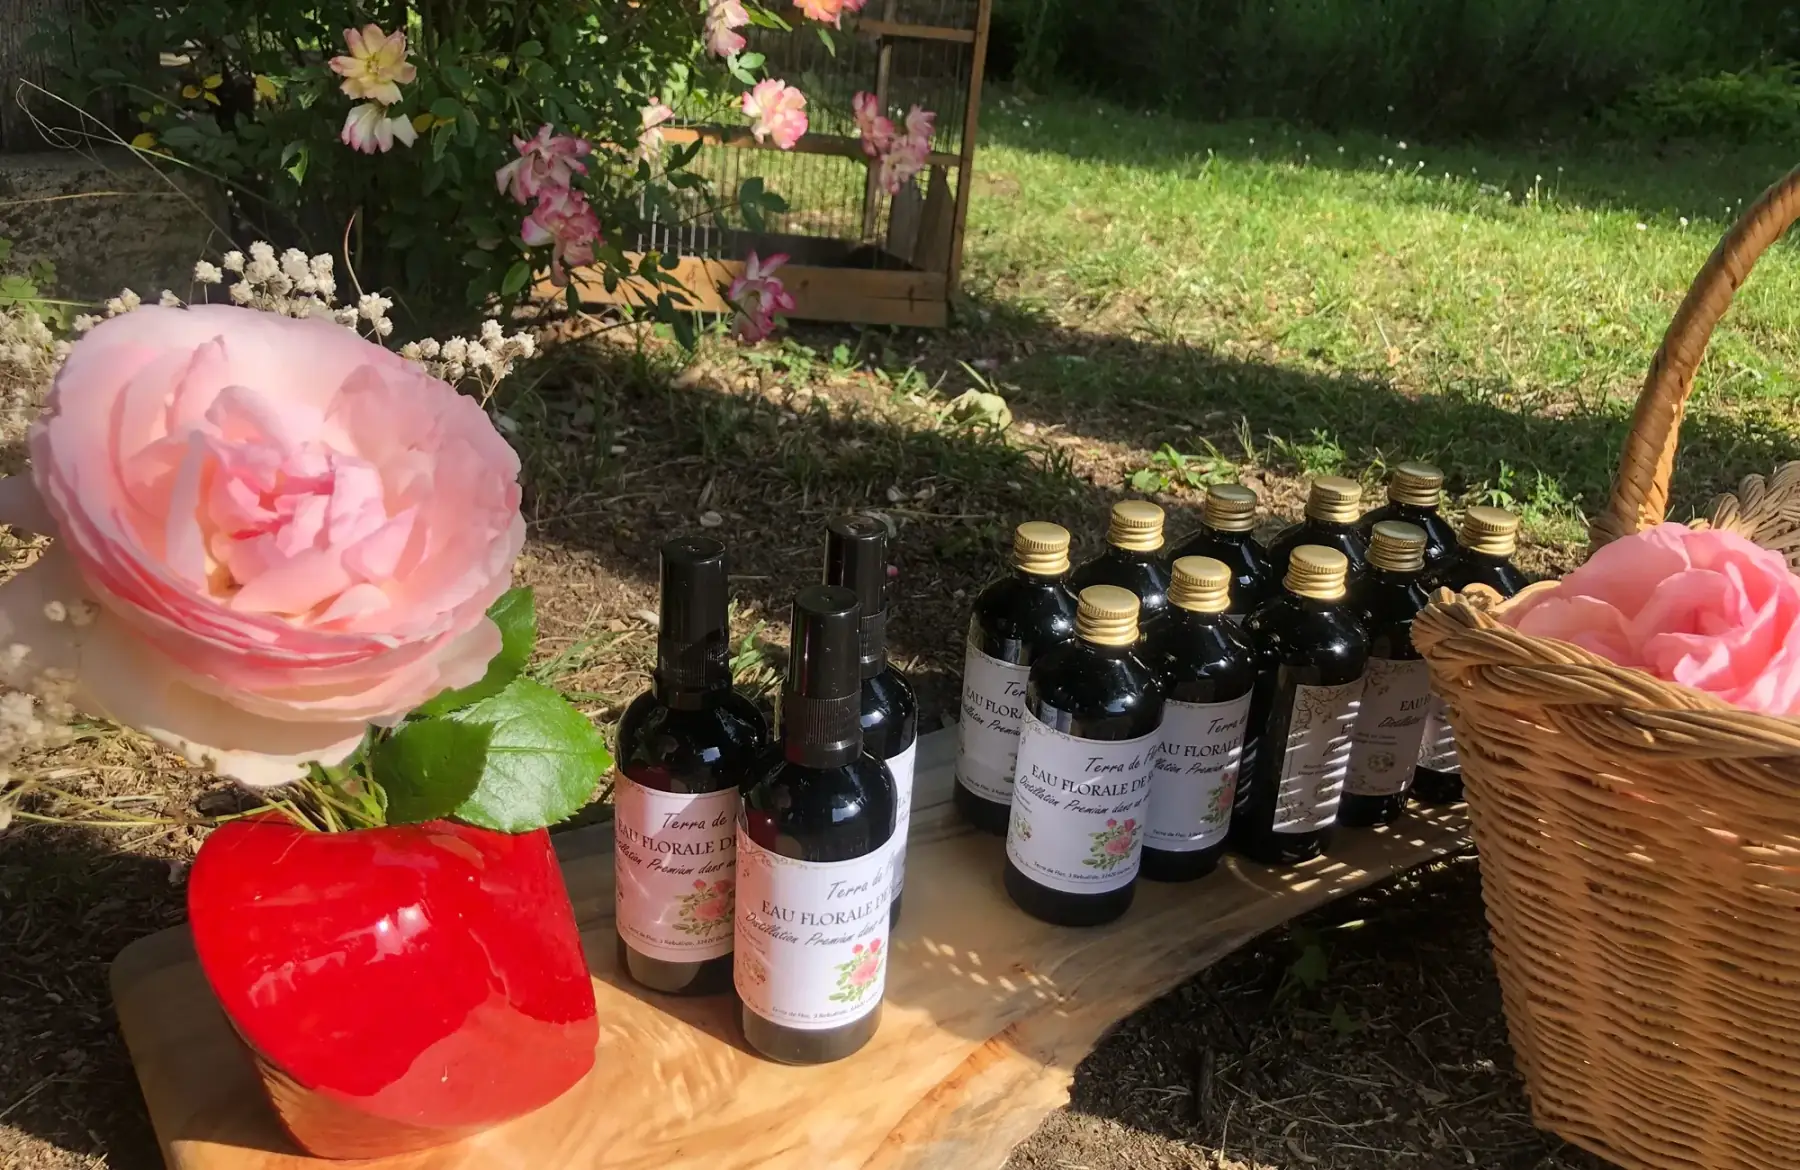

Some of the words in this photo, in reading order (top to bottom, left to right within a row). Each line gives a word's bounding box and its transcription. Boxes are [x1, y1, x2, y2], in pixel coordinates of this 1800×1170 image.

[1004, 682, 1026, 697] Ter
[985, 699, 1023, 720] FLOR
[986, 719, 1021, 736] Premiu
[1157, 741, 1180, 756] AU
[1084, 757, 1124, 773] Terra
[1128, 755, 1140, 771] de
[1032, 763, 1058, 787] EAU
[1062, 778, 1129, 797] FLORALE
[1019, 774, 1060, 807] Distillation
[1064, 799, 1109, 815] Premium
[663, 811, 706, 830] Terra
[711, 810, 728, 828] de
[617, 817, 639, 843] EAU
[642, 834, 715, 856] FLORALE
[647, 858, 696, 876] Premium
[698, 860, 724, 875] dans
[827, 879, 868, 900] Terra
[762, 899, 795, 923] EAU
[799, 902, 873, 926] FLORALE
[745, 911, 800, 944] Distillation
[804, 931, 856, 946] Premium
